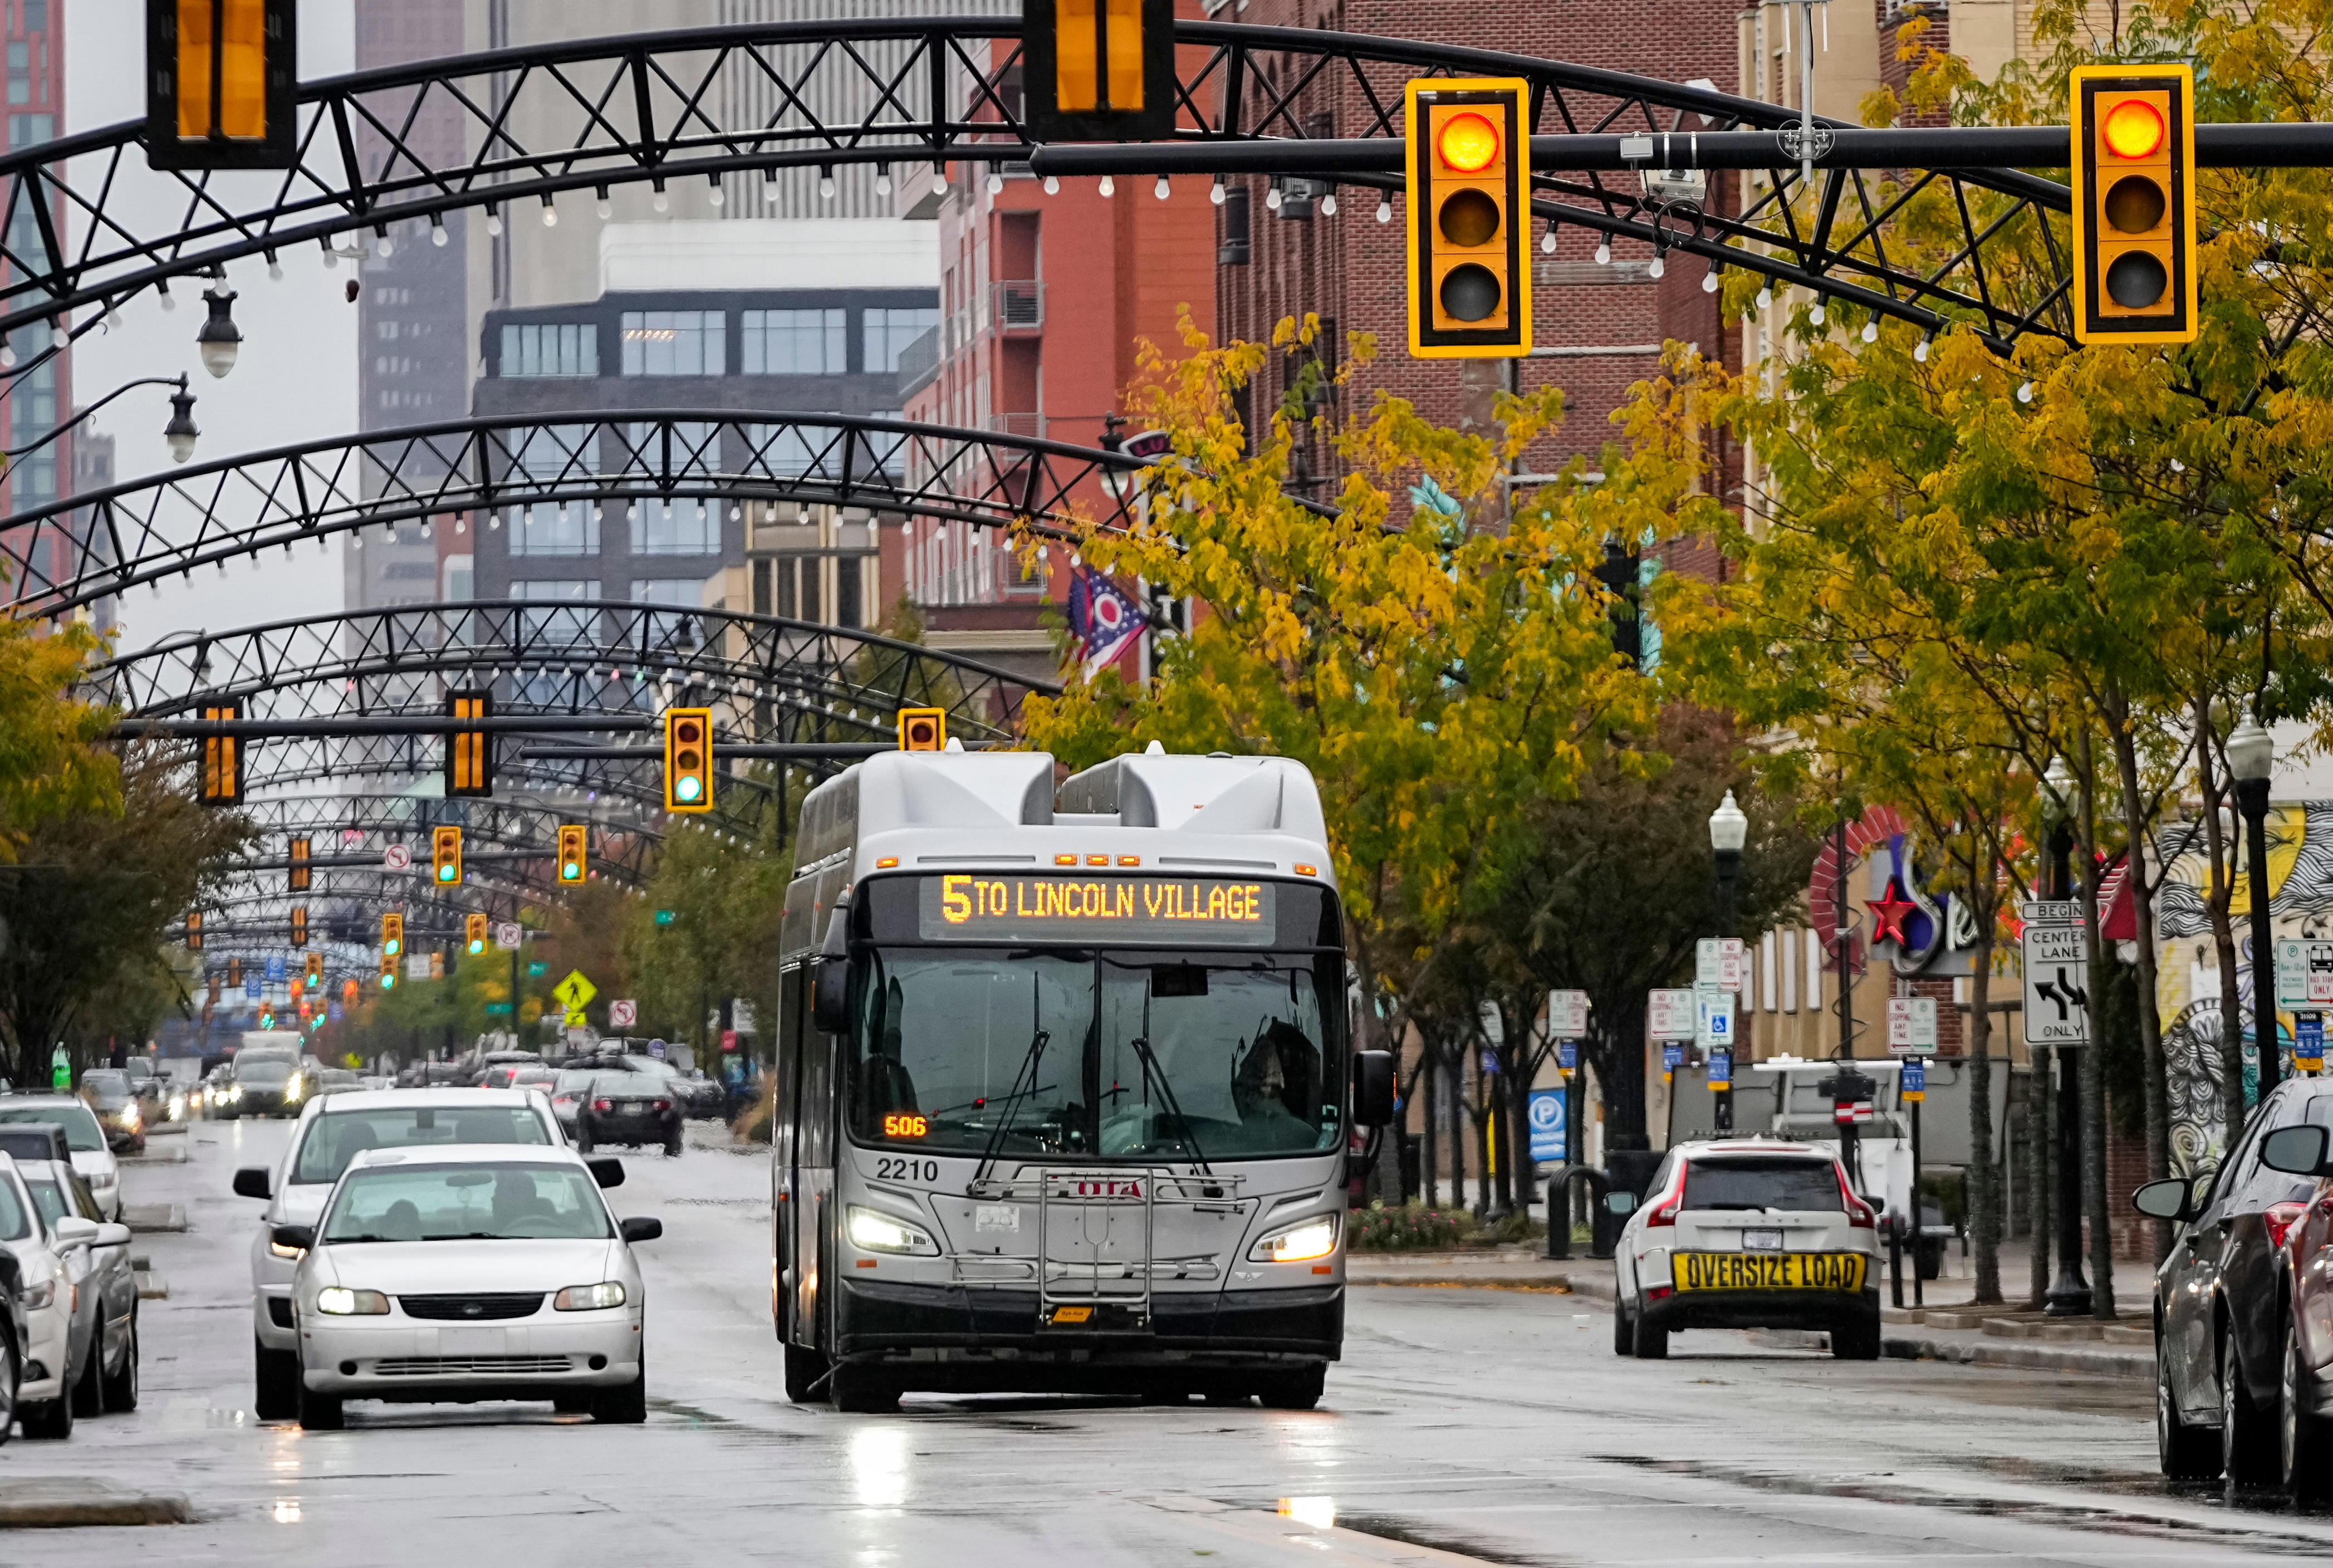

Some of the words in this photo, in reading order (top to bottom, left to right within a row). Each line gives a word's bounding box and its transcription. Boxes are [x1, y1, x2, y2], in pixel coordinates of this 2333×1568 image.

[943, 875, 972, 923] 5
[974, 881, 1007, 916] TO
[1017, 881, 1135, 918] LINCOLN
[1144, 884, 1261, 919] VILLAGE
[2038, 905, 2082, 917] BEGIN
[2032, 930, 2086, 943] CENTER
[2041, 946, 2081, 958] LANE
[2314, 984, 2330, 994] ONLY
[2043, 1026, 2083, 1037] ONLY
[885, 1116, 927, 1136] 506
[877, 1158, 938, 1181] 2210
[1688, 1254, 1792, 1287] OVERSIZE
[1801, 1255, 1856, 1289] LOAD
